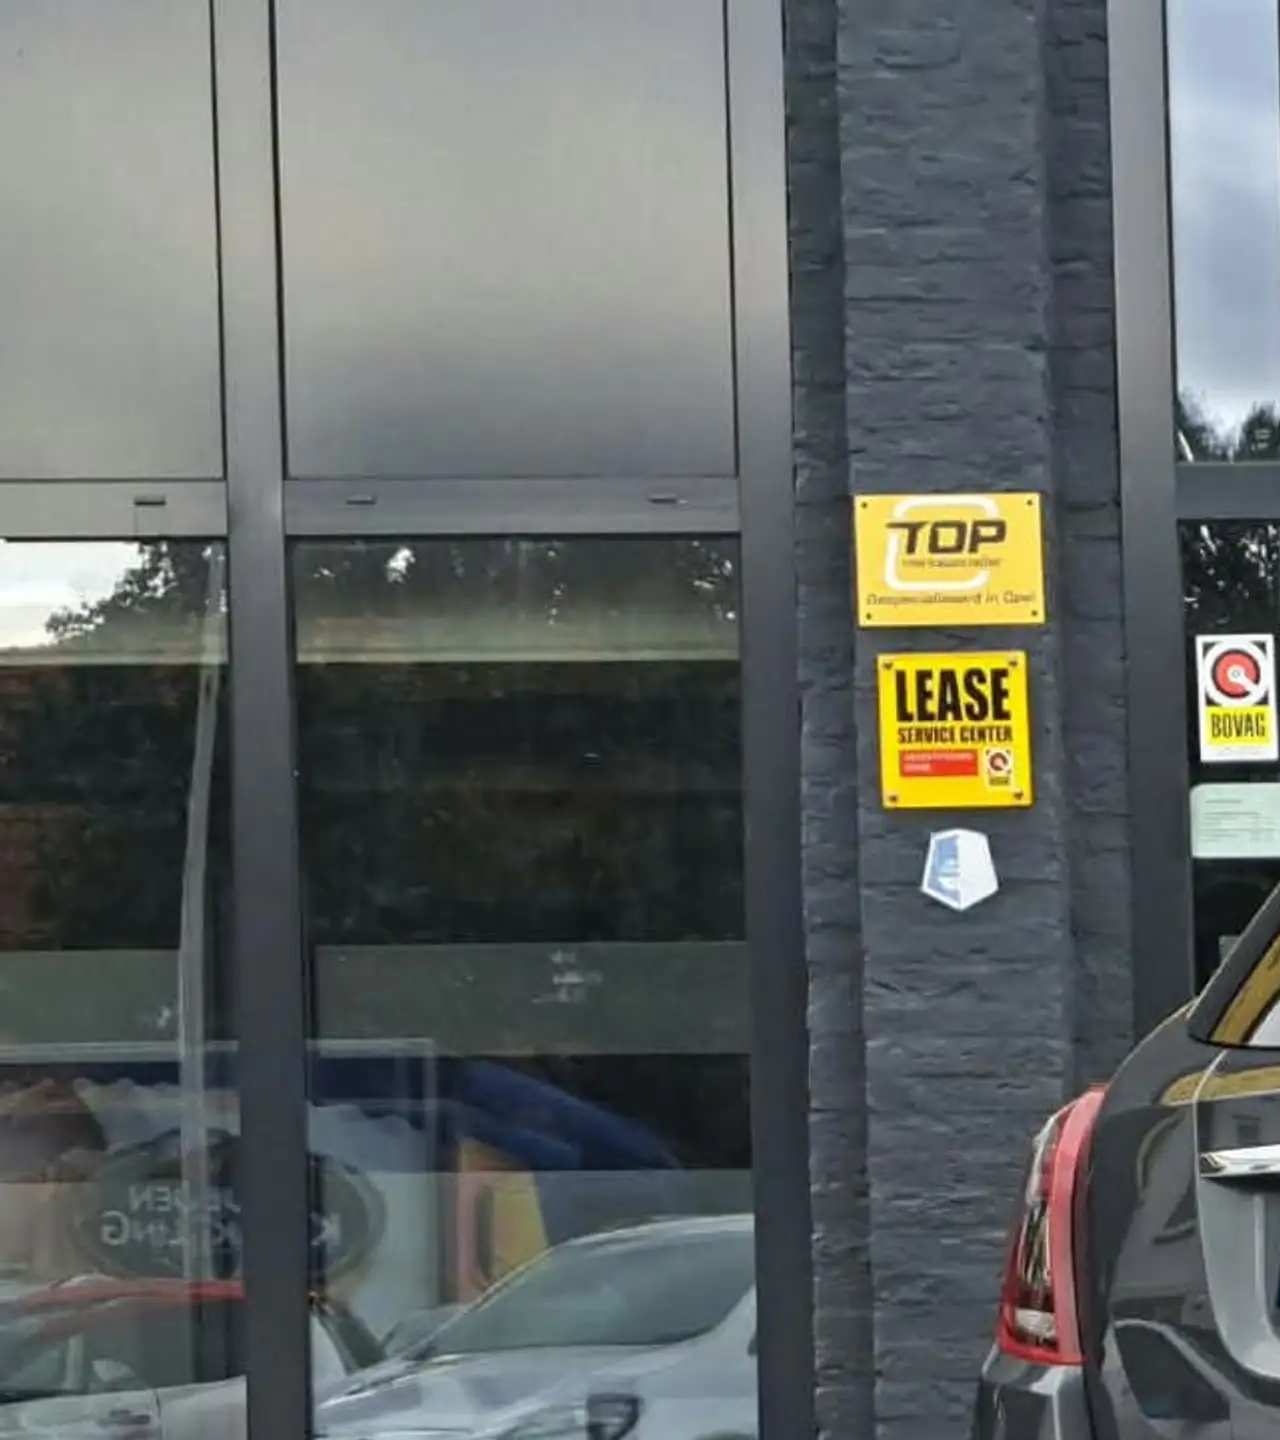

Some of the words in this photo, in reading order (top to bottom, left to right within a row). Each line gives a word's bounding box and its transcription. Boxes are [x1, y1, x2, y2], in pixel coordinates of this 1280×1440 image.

[886, 519, 1007, 555] TOP
[895, 668, 1012, 722] LEASE
[898, 727, 955, 744] SERVICE
[960, 725, 1013, 743] CENTER
[1211, 712, 1266, 739] BOVAG
